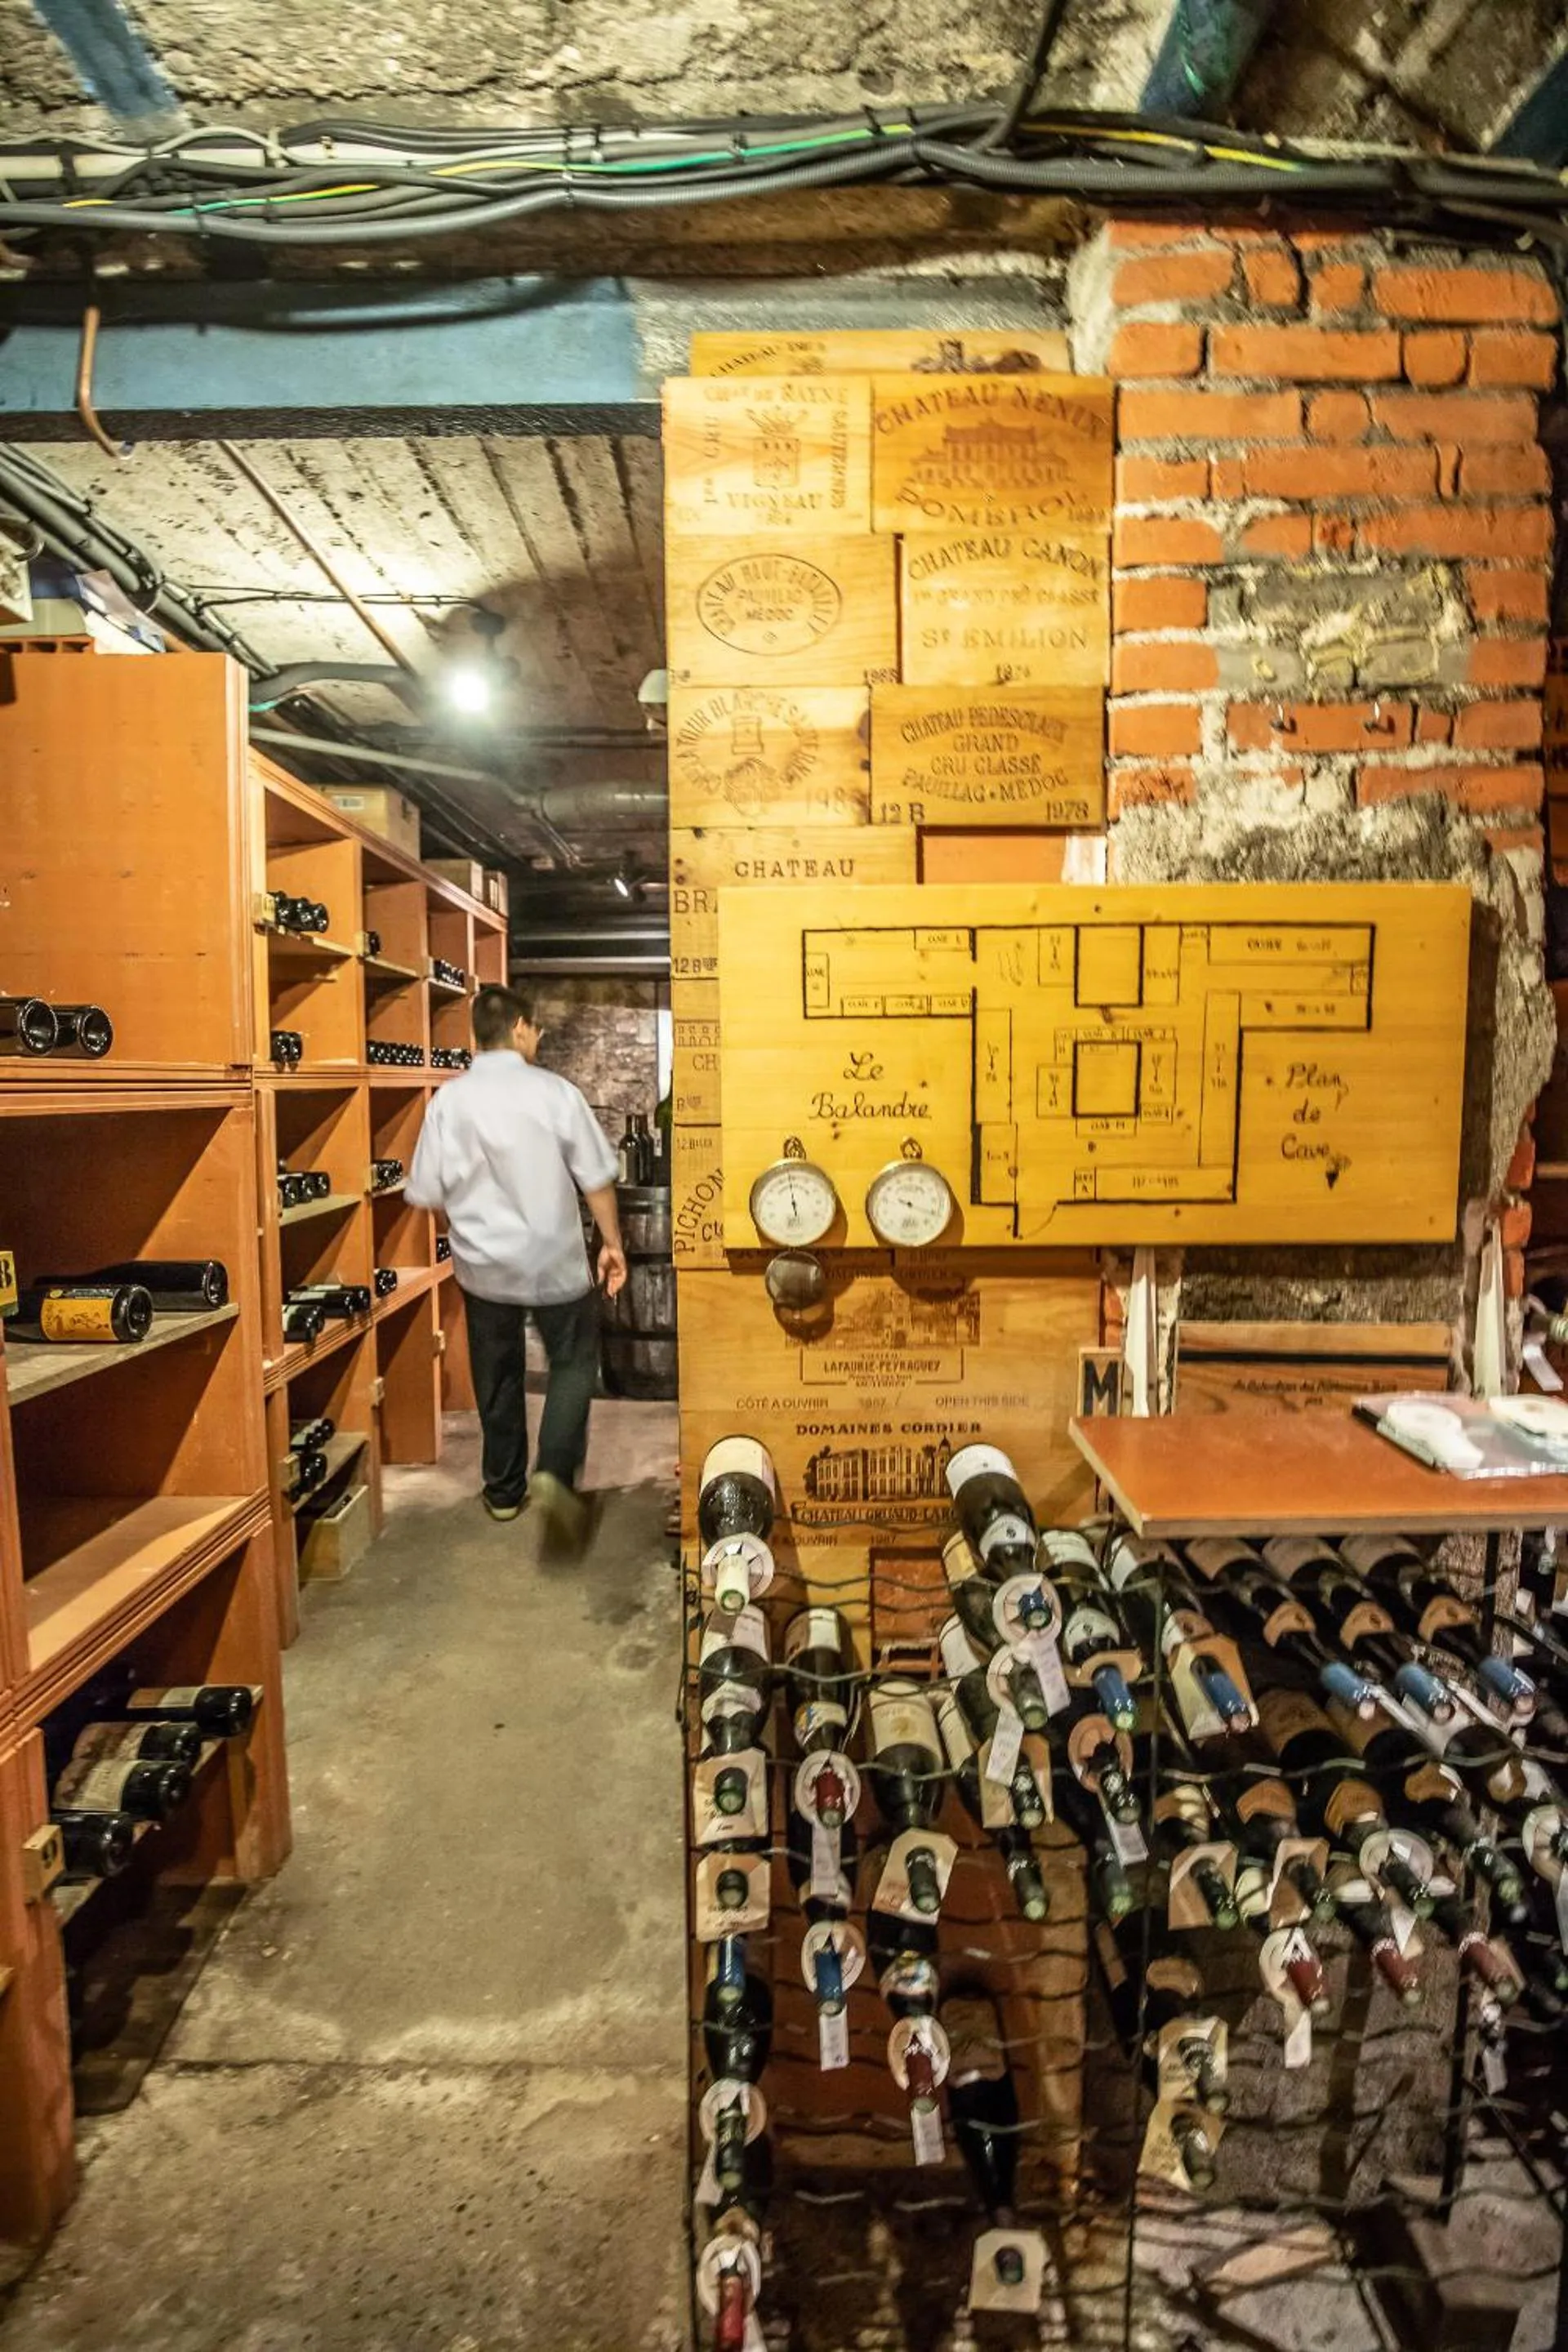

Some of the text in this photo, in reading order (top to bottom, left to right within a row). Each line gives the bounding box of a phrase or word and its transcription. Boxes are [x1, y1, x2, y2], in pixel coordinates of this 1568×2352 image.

[875, 382, 1000, 435] CHATEAU
[908, 537, 1011, 581] CHATEAU
[962, 628, 1089, 649] EMILION
[900, 708, 964, 744] CHATEAU
[952, 733, 1020, 753] GRAND
[930, 755, 966, 776] CRU
[880, 803, 925, 823] 12 B
[734, 858, 855, 878] CHATEAU
[674, 958, 688, 973] 12
[843, 1051, 884, 1081] Le
[808, 1090, 933, 1120] Balandre
[1293, 1097, 1321, 1125] de
[1281, 1132, 1331, 1160] Cave
[674, 1167, 726, 1254] PICHON
[935, 1395, 969, 1407] OPEN
[1001, 1394, 1030, 1407] SIDE
[1084, 1359, 1119, 1415] M
[795, 1420, 982, 1436] DOMAINES CORDIER
